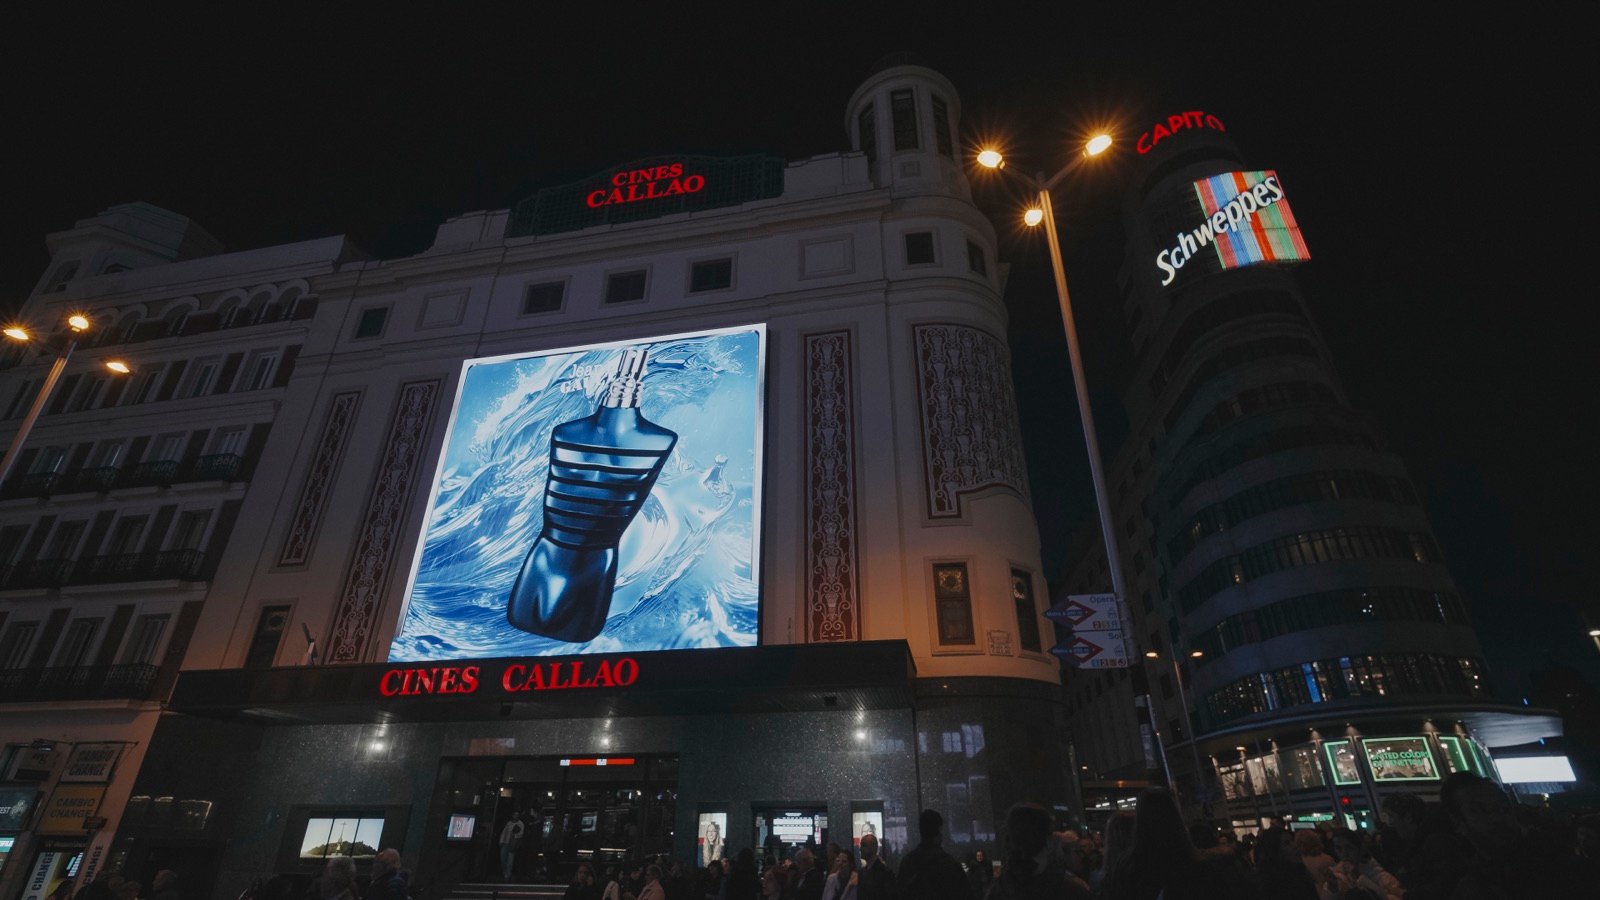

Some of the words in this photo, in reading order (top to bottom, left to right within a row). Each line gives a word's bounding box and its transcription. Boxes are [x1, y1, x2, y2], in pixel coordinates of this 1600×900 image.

[586, 174, 706, 209] CALLAO
[612, 163, 684, 187] CINES
[1155, 175, 1283, 287] Schweppes
[378, 665, 481, 698] CINES
[501, 657, 640, 693] CALLAO
[50, 809, 94, 819] CHANGE
[56, 797, 96, 808] CAMBIO
[31, 851, 55, 891] CHANGE
